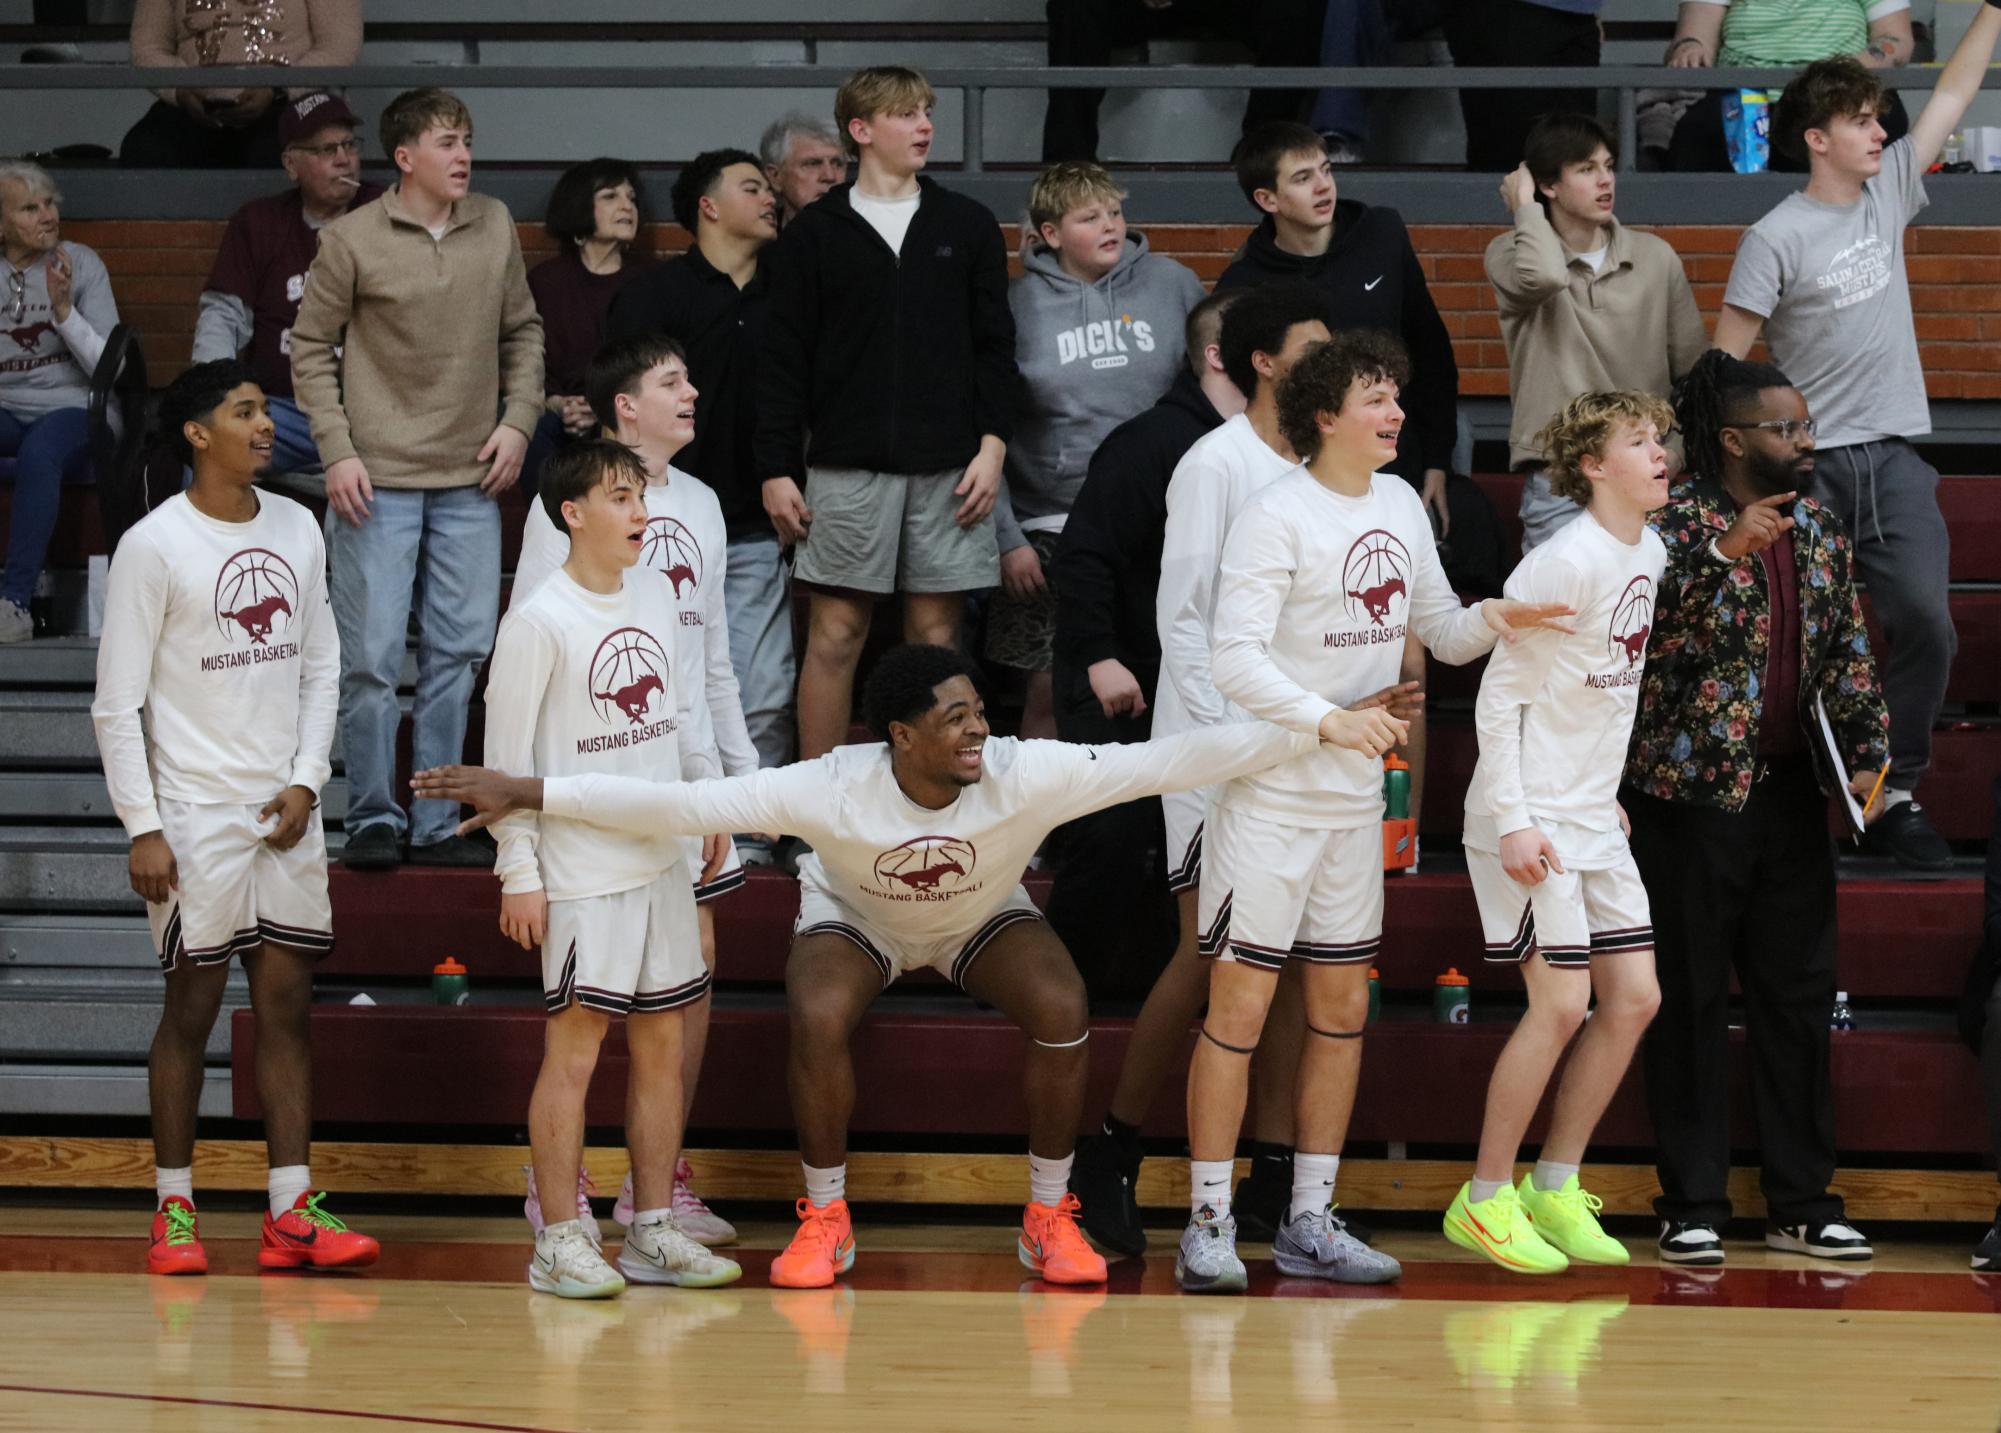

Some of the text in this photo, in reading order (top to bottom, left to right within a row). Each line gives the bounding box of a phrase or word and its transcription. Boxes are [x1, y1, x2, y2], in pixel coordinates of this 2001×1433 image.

[1057, 313, 1155, 366] DICK'S
[1323, 630, 1369, 648] MUSTANG
[201, 650, 251, 672] MUSTANG
[576, 731, 629, 755] MUSTANG
[859, 884, 911, 902] MUSTANG
